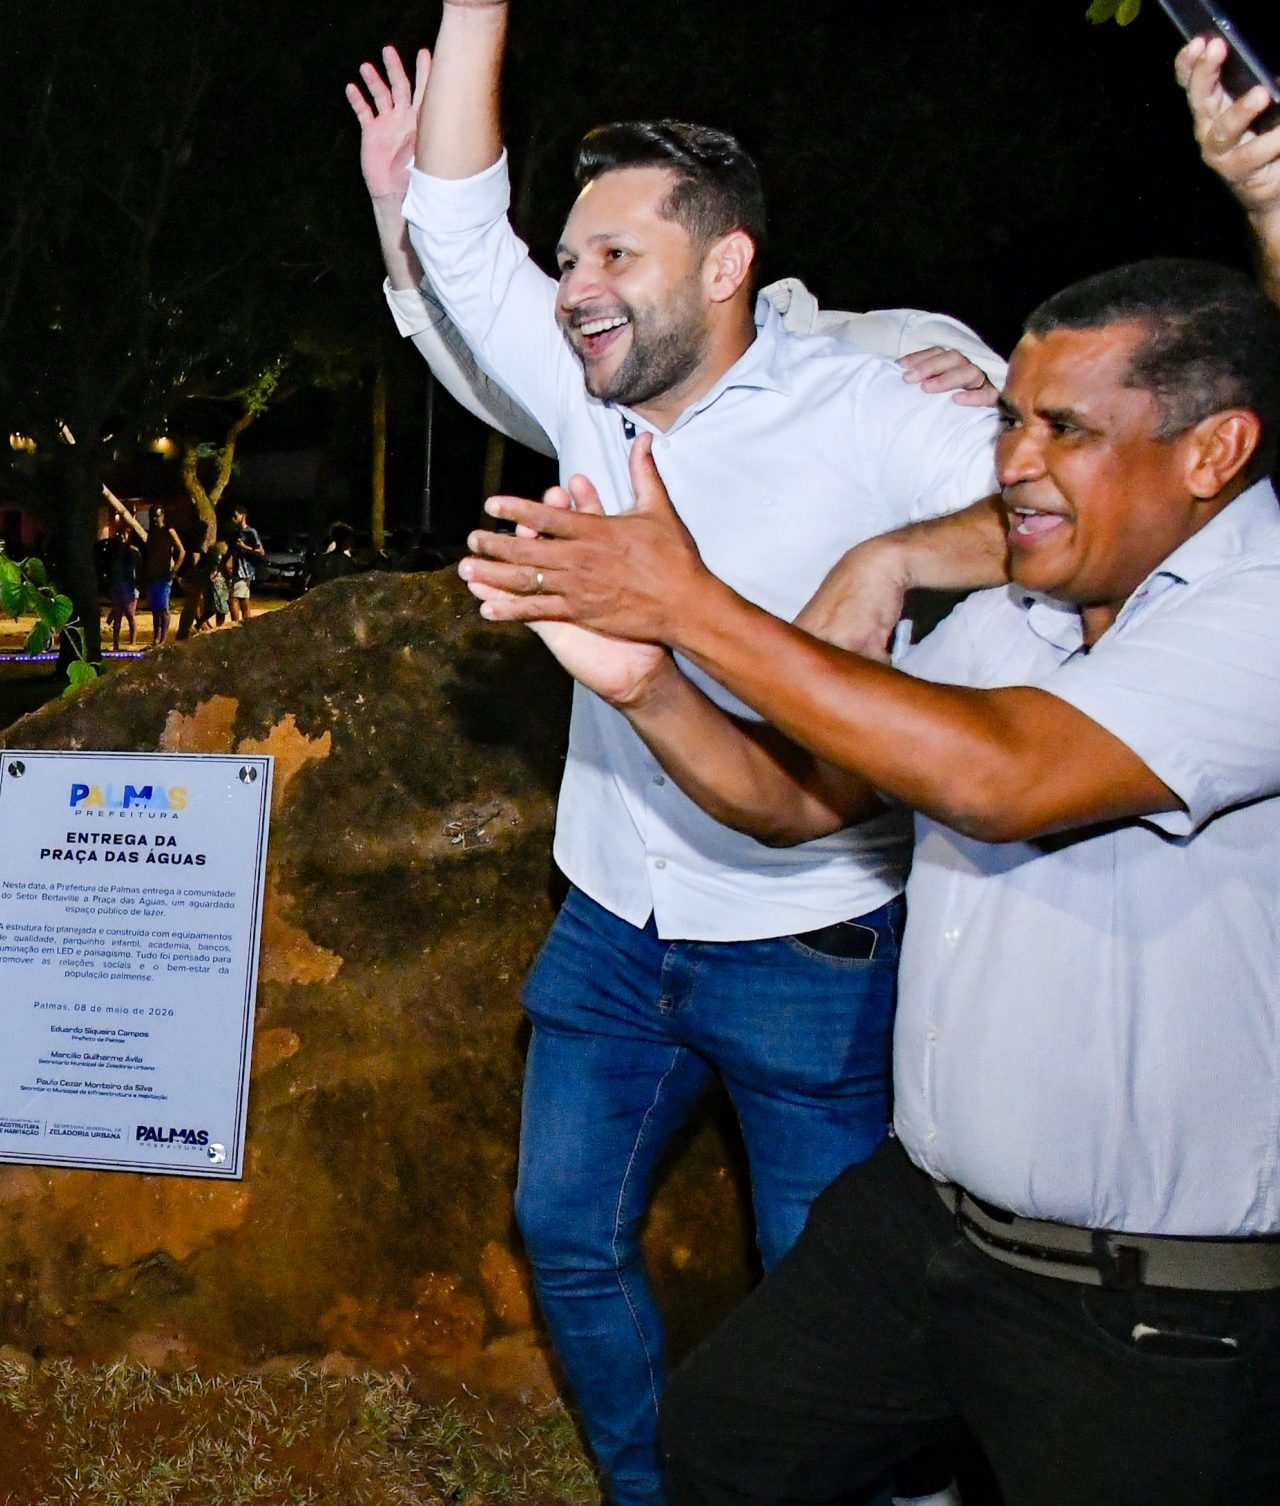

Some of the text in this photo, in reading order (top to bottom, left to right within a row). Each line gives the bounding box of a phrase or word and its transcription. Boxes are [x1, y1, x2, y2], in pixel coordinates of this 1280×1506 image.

[70, 784, 188, 810] PALMAS
[75, 810, 179, 819] PREFEITURA
[66, 832, 177, 847] ENTREGA DA
[40, 849, 206, 866] PRAÇA DAS ÁGUAS
[2, 881, 26, 889] Nesta
[110, 885, 140, 894] Palmas
[142, 887, 174, 896] entrega
[184, 889, 236, 897] comunidade
[42, 893, 79, 902] Bertaville
[93, 895, 116, 904] Praça
[189, 900, 235, 909] aguardado
[65, 906, 95, 914] espaço
[56, 925, 96, 935] planejada
[171, 931, 232, 941] equipamentos
[63, 938, 105, 946] parquinho
[136, 951, 157, 959] Tudo
[173, 954, 210, 962] pensado
[59, 959, 94, 967] relações
[103, 961, 131, 969] sociais
[167, 964, 210, 973] bem-estar
[65, 971, 108, 980] população
[74, 1003, 86, 1012] 08
[106, 1006, 129, 1014] maio
[133, 1007, 144, 1015] de
[149, 1008, 174, 1017] 2026
[50, 1025, 149, 1038] Eduardo Siqueira Campos
[84, 1053, 123, 1062] Guilherme
[36, 1078, 58, 1086] Paulo
[84, 1081, 122, 1090] Monteiro
[49, 1129, 89, 1137] ZELADORIA
[136, 1126, 209, 1145] PALMAS
